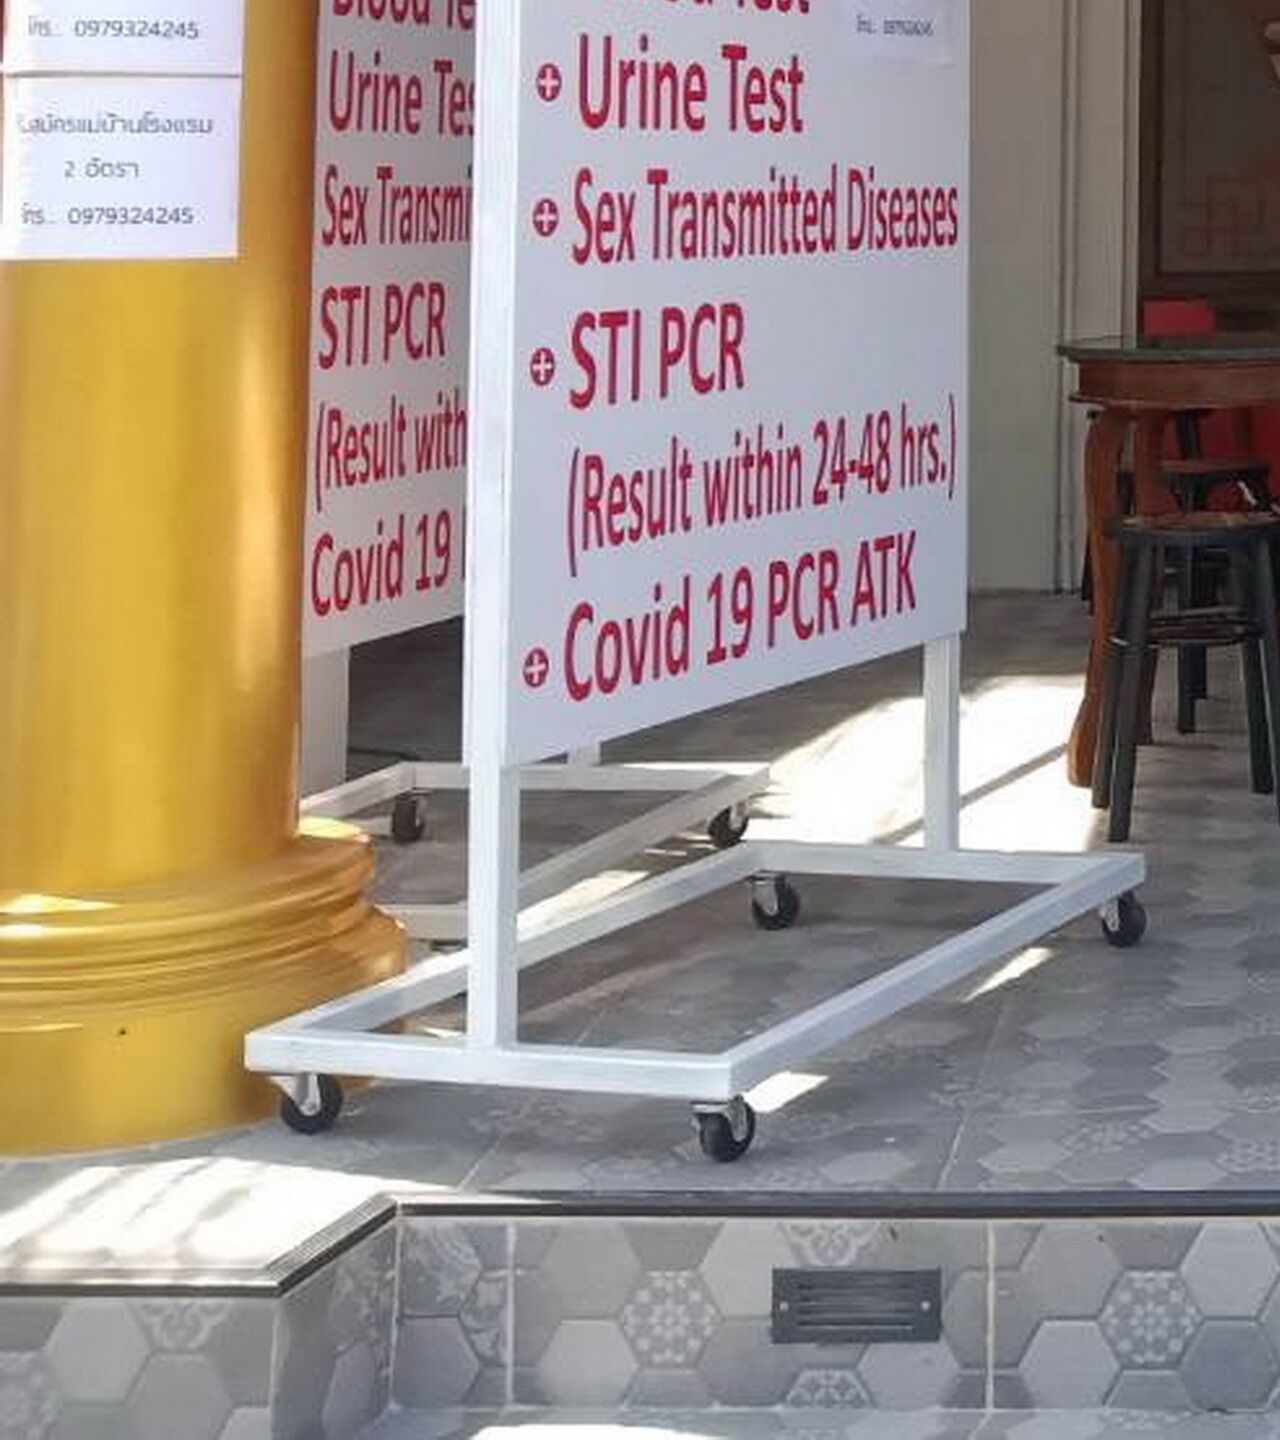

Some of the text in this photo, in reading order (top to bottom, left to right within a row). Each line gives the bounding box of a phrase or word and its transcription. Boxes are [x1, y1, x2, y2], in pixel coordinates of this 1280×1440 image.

[74, 19, 200, 40] 0979324245
[330, 49, 423, 135] Urine
[578, 34, 804, 134] Urine Test
[64, 161, 76, 179] 2
[67, 207, 195, 227] 0979324245
[321, 163, 369, 247] Sex
[571, 163, 959, 266] Sex Transmitted Diseases
[319, 281, 446, 370] STI PCR
[569, 302, 745, 410] STI PCR
[315, 394, 406, 514] (Result
[566, 394, 956, 578] (Result within 24-48 hrs.)
[312, 510, 452, 618] Covid 19
[563, 530, 917, 702] Covid 19 PCR ATK
